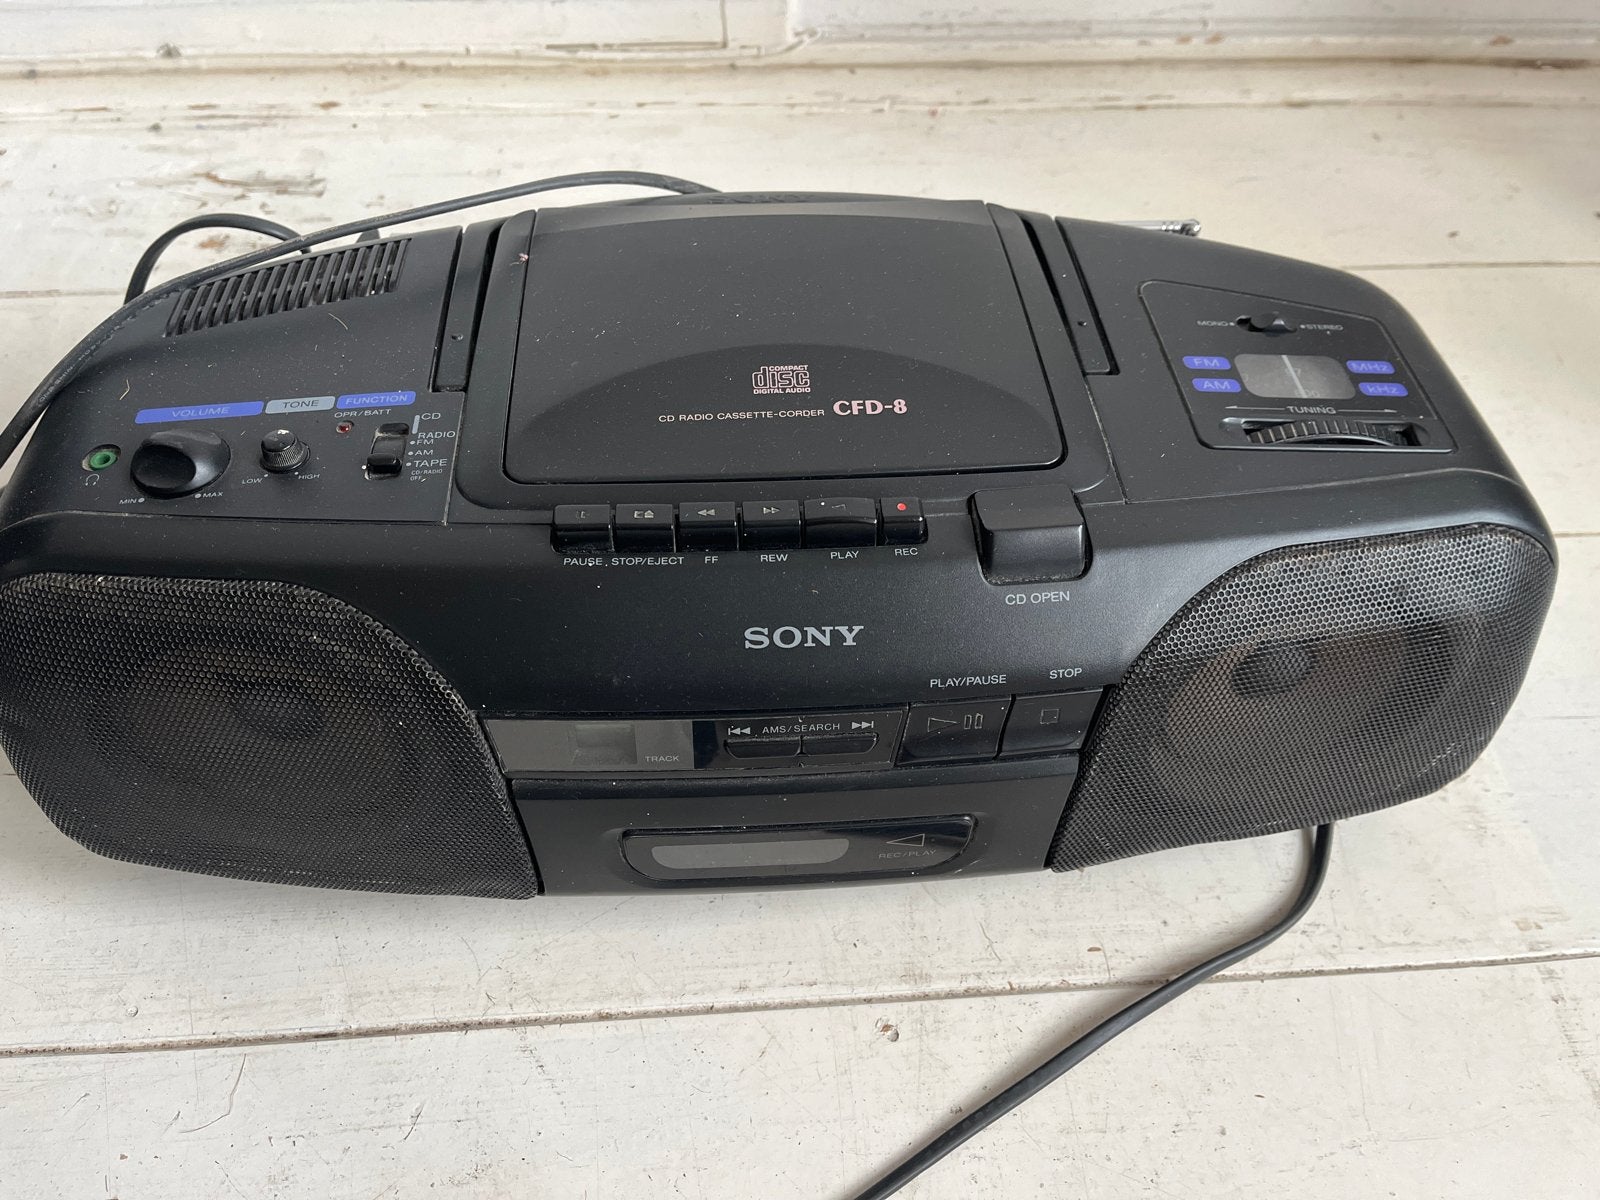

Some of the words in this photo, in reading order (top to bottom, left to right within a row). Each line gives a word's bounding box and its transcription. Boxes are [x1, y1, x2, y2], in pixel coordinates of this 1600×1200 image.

[1197, 319, 1229, 327] MONO
[1306, 323, 1344, 331] STEREO
[1193, 358, 1220, 368] FM
[1352, 362, 1388, 372] MHz
[752, 366, 810, 389] disc
[1202, 380, 1231, 390] AM
[1367, 384, 1401, 394] kHz
[282, 399, 320, 410] TONE
[345, 394, 408, 405] FUNCTION
[172, 405, 229, 418] VOLUME
[833, 399, 908, 416] CFD-8
[1286, 405, 1337, 415] TUNING
[334, 408, 392, 419] OPR/BATT
[421, 412, 442, 420] CD
[658, 414, 675, 422] CD
[679, 413, 714, 421] RADIO
[716, 409, 825, 420] CASSETTE-CORDER
[417, 430, 456, 439] RADIO
[413, 458, 448, 468] TAPE
[298, 473, 321, 481] HIGH
[411, 468, 443, 476] CD/RADIO
[242, 477, 263, 485] LOW
[202, 490, 224, 499] MAX
[118, 497, 138, 505] MIN
[830, 550, 860, 560] PLAY
[894, 547, 919, 557] REC
[563, 557, 603, 566] PAUSE
[611, 556, 685, 566] STOP/EJECT
[704, 555, 719, 564] FF
[760, 553, 789, 563] REW
[1005, 593, 1027, 605] CD
[1030, 591, 1070, 604] OPEN
[744, 625, 864, 650] SONY
[1049, 668, 1082, 680] STOP
[930, 674, 1007, 688] PLAY/PAUSE
[761, 722, 841, 734] AMS/SEARCH
[645, 754, 680, 763] TRACK
[878, 848, 937, 860] REC/PLAY
